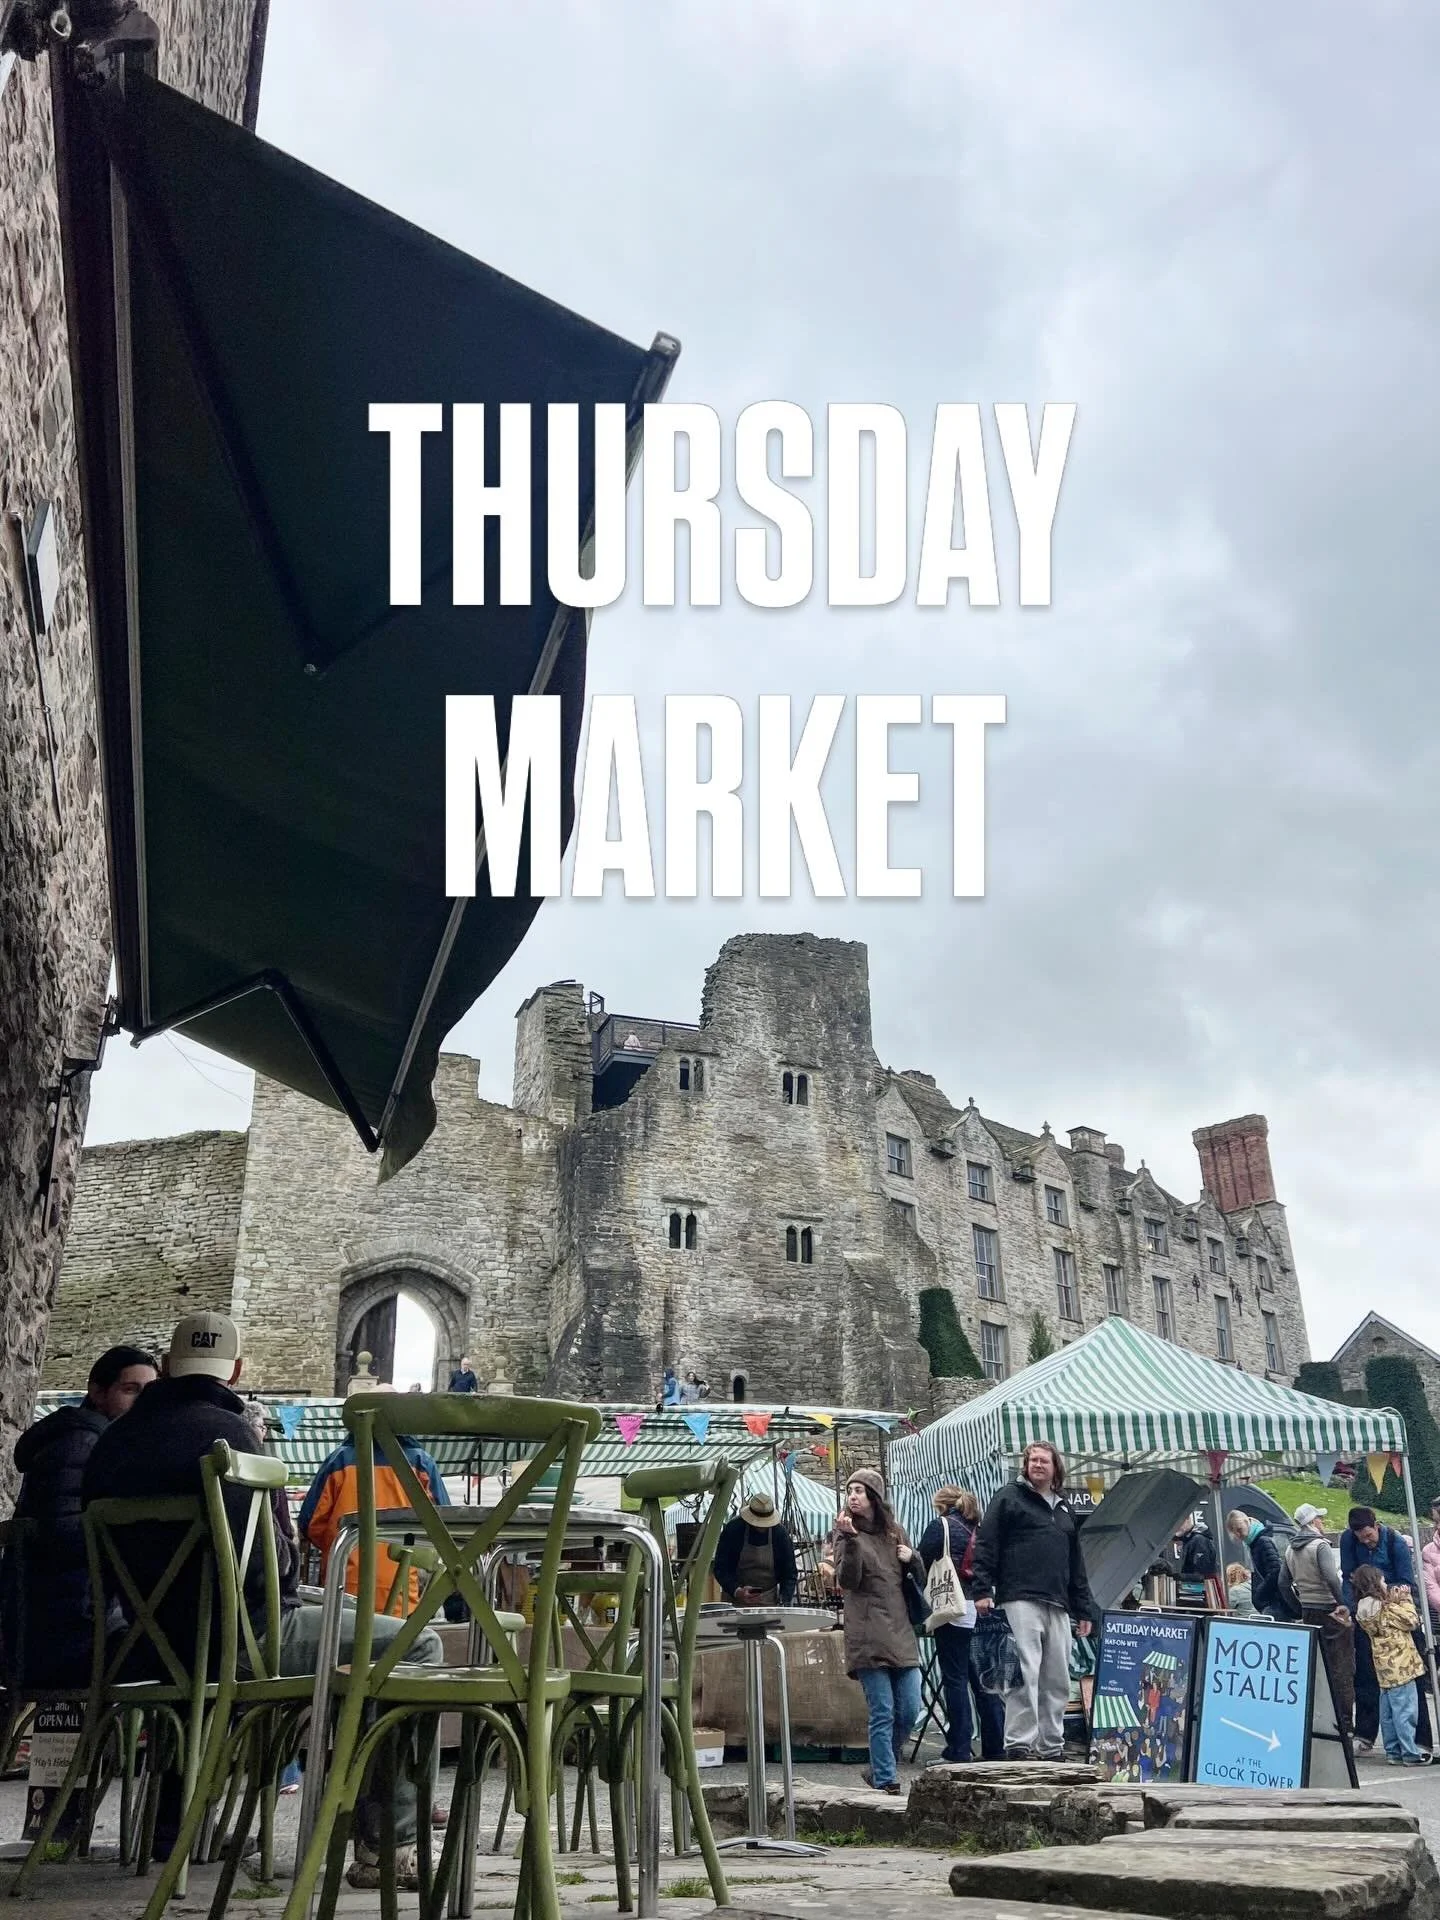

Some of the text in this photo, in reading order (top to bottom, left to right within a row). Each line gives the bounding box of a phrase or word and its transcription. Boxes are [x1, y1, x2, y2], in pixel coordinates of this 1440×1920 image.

[191, 1331, 219, 1348] CAT
[1106, 1622, 1189, 1640] SATURDAY MARKET
[1214, 1637, 1300, 1675] MORE
[1212, 1669, 1299, 1705] STALLS
[39, 1714, 81, 1727] OPEN ALL
[1235, 1757, 1262, 1768] AT THE
[1204, 1762, 1294, 1789] CLOCK TOWER
